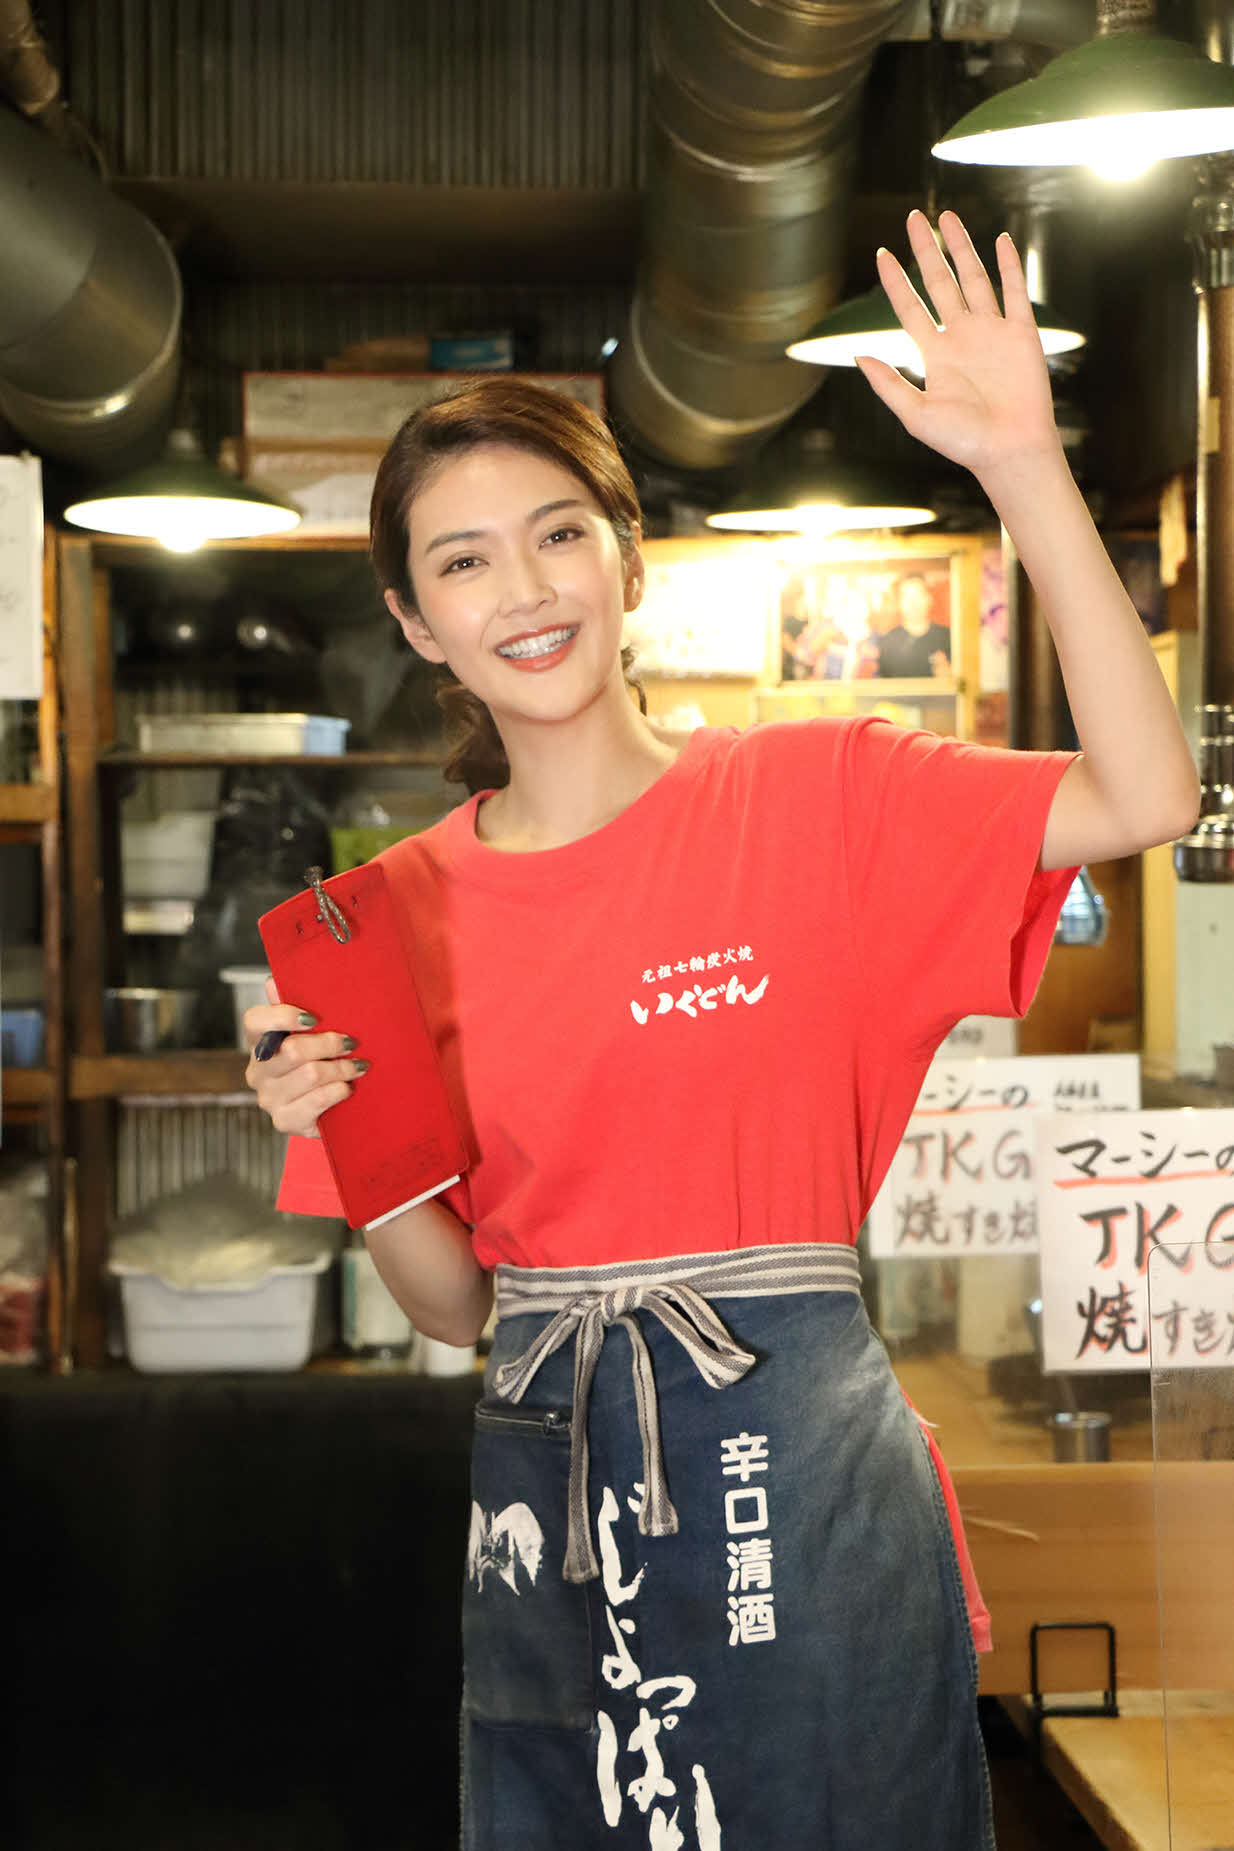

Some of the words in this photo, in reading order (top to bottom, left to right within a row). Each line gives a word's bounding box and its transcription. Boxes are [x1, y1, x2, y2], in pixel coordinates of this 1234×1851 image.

[902, 1129, 1032, 1184] TKG
[1075, 1281, 1234, 1359] 焼すき
[721, 1432, 776, 1646] 辛口清酒
